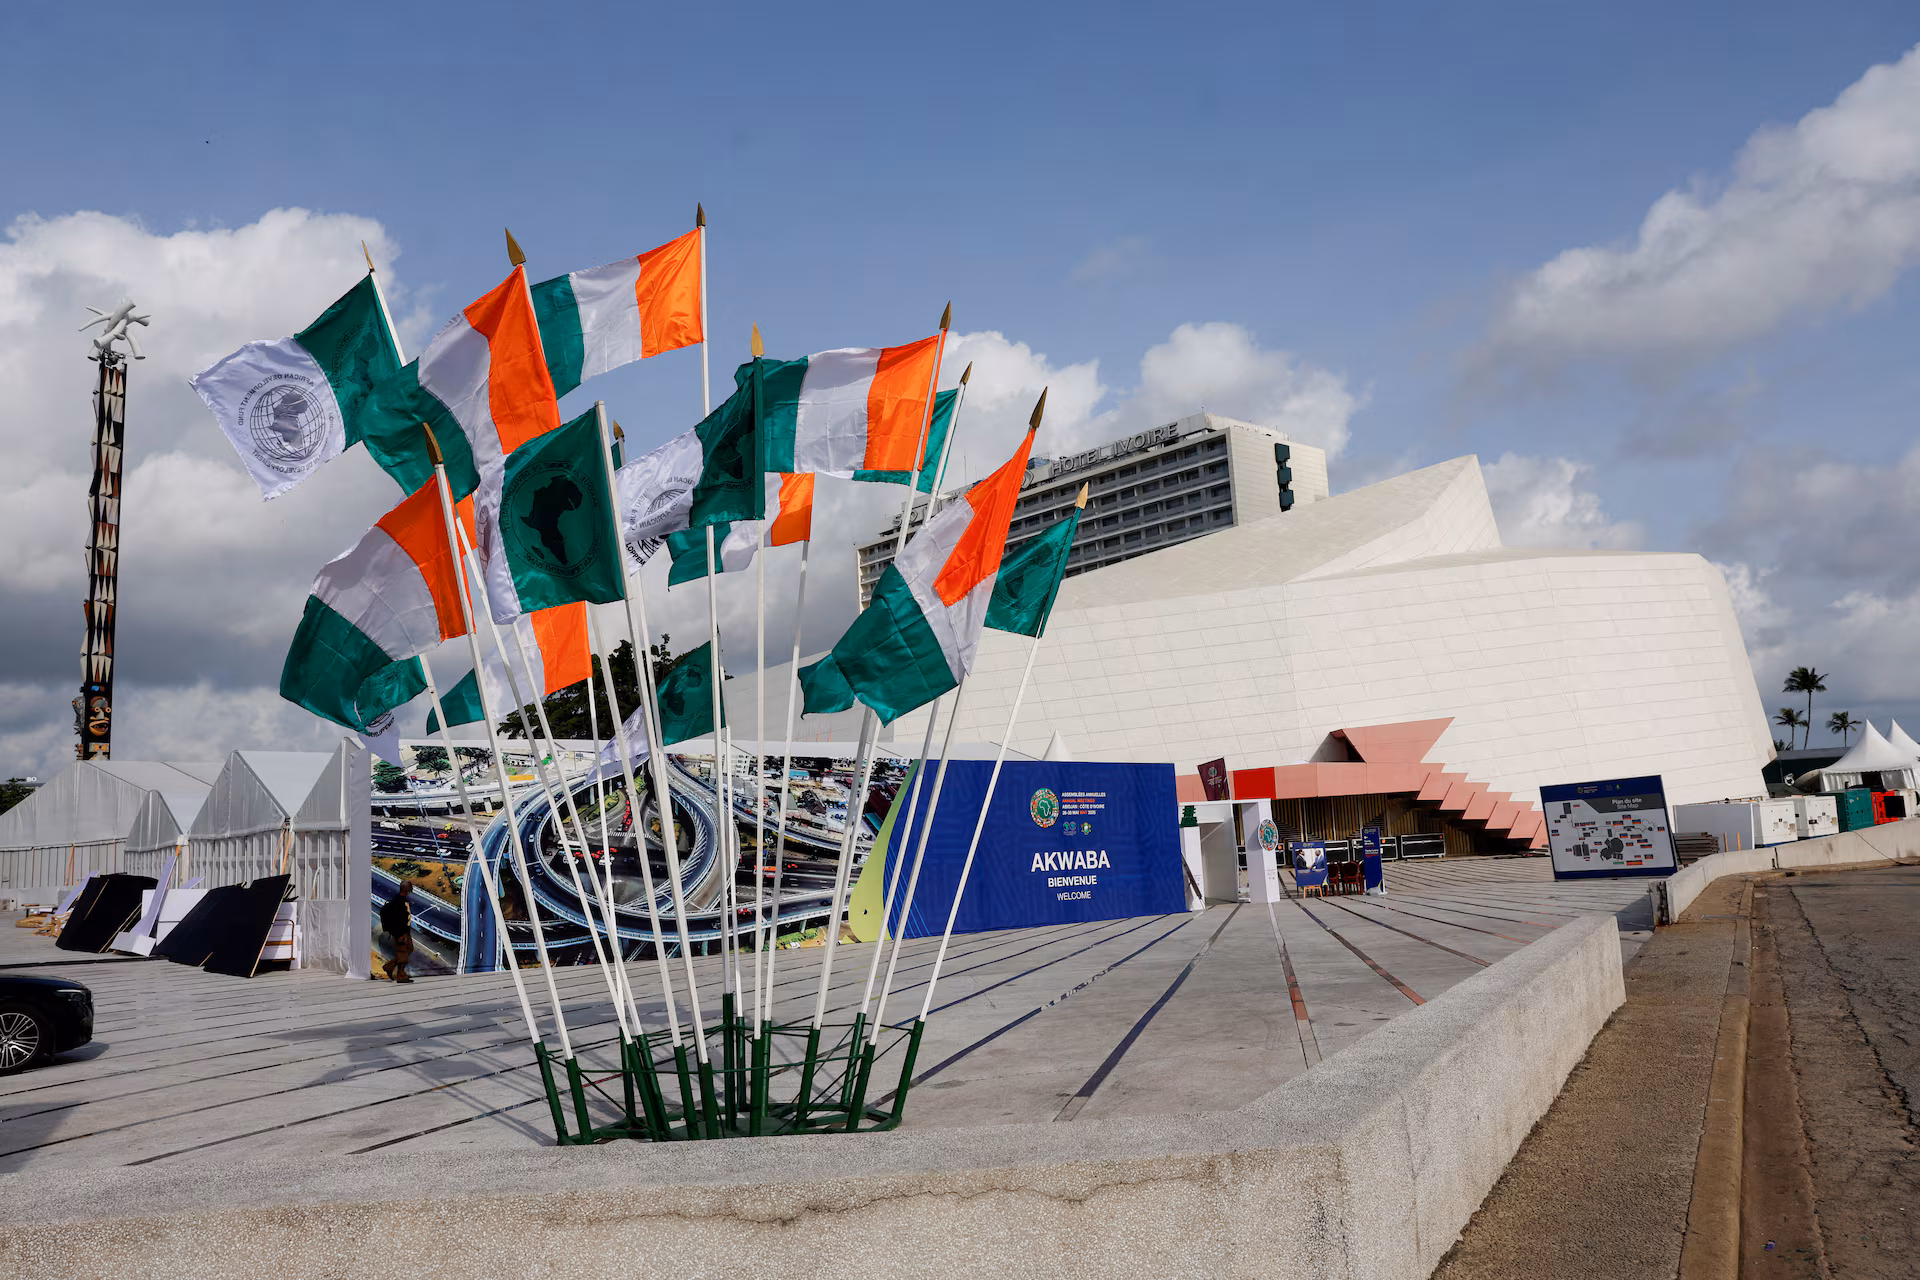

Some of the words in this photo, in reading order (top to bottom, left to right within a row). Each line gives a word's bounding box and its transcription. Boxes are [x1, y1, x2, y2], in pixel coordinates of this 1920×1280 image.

[1050, 446, 1108, 476] HOTEL
[1114, 421, 1180, 455] IVOIRE
[625, 542, 646, 566] LOPPEM
[1031, 850, 1111, 872] AKWABA
[1048, 875, 1098, 888] BIENVENUE
[1057, 891, 1092, 901] WELCOME
